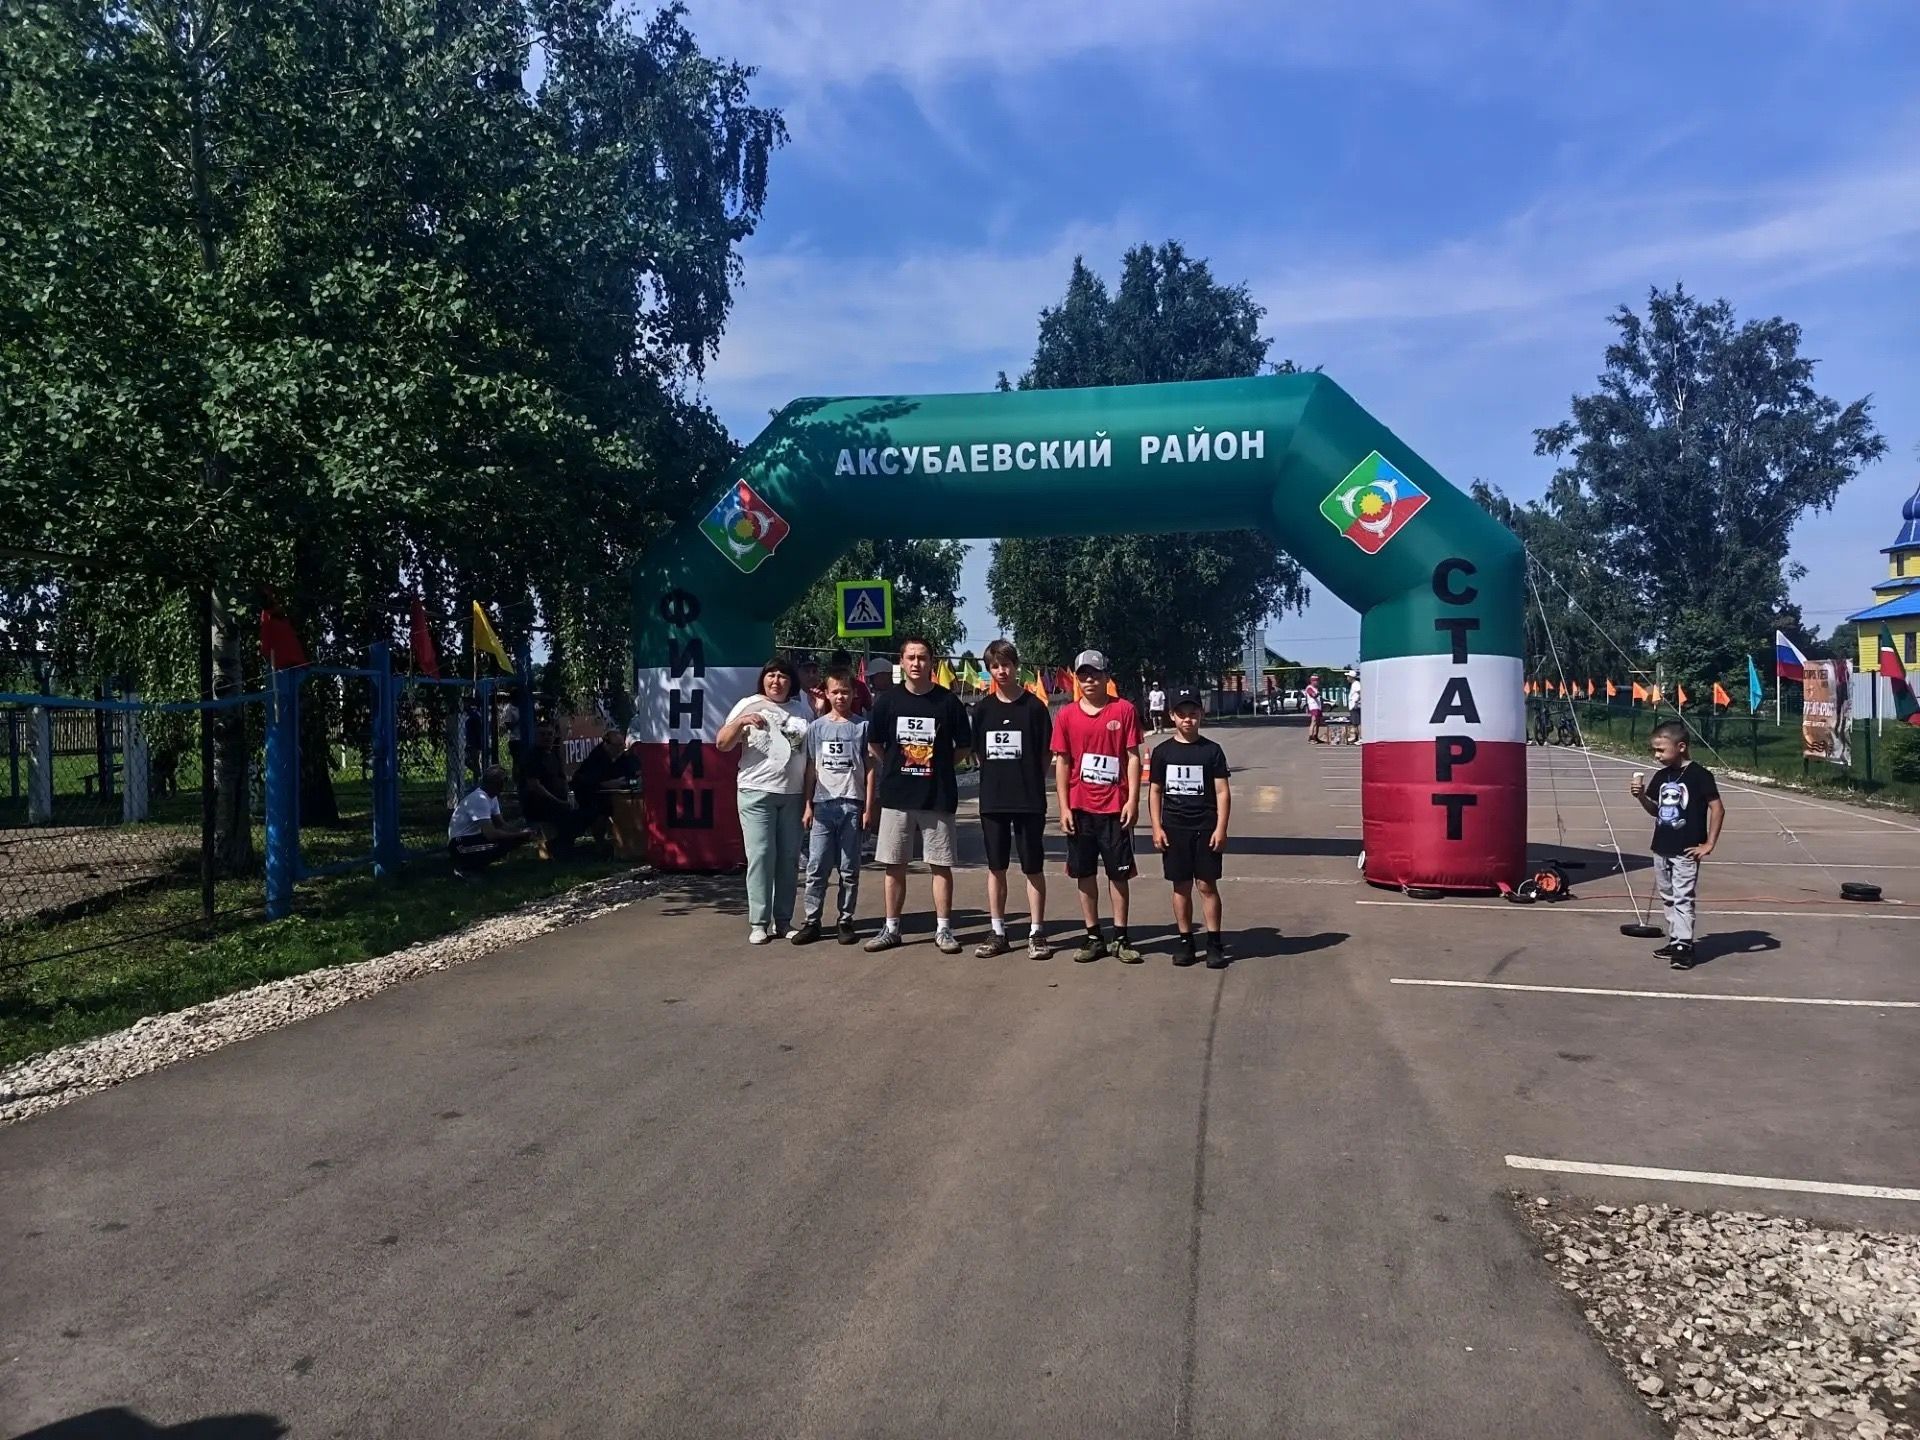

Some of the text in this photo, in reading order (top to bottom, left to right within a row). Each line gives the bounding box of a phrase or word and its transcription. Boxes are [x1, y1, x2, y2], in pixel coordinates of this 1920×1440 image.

[834, 425, 1265, 477] АКСУБАЕВСКИЙ РАЙОН
[1429, 557, 1481, 840] СТАРТ
[660, 588, 713, 829] ФИНИШ
[908, 718, 923, 730] 52
[994, 733, 1010, 743] 62
[829, 744, 843, 754] 53
[1092, 756, 1108, 769] 71
[1177, 767, 1191, 778] 11
